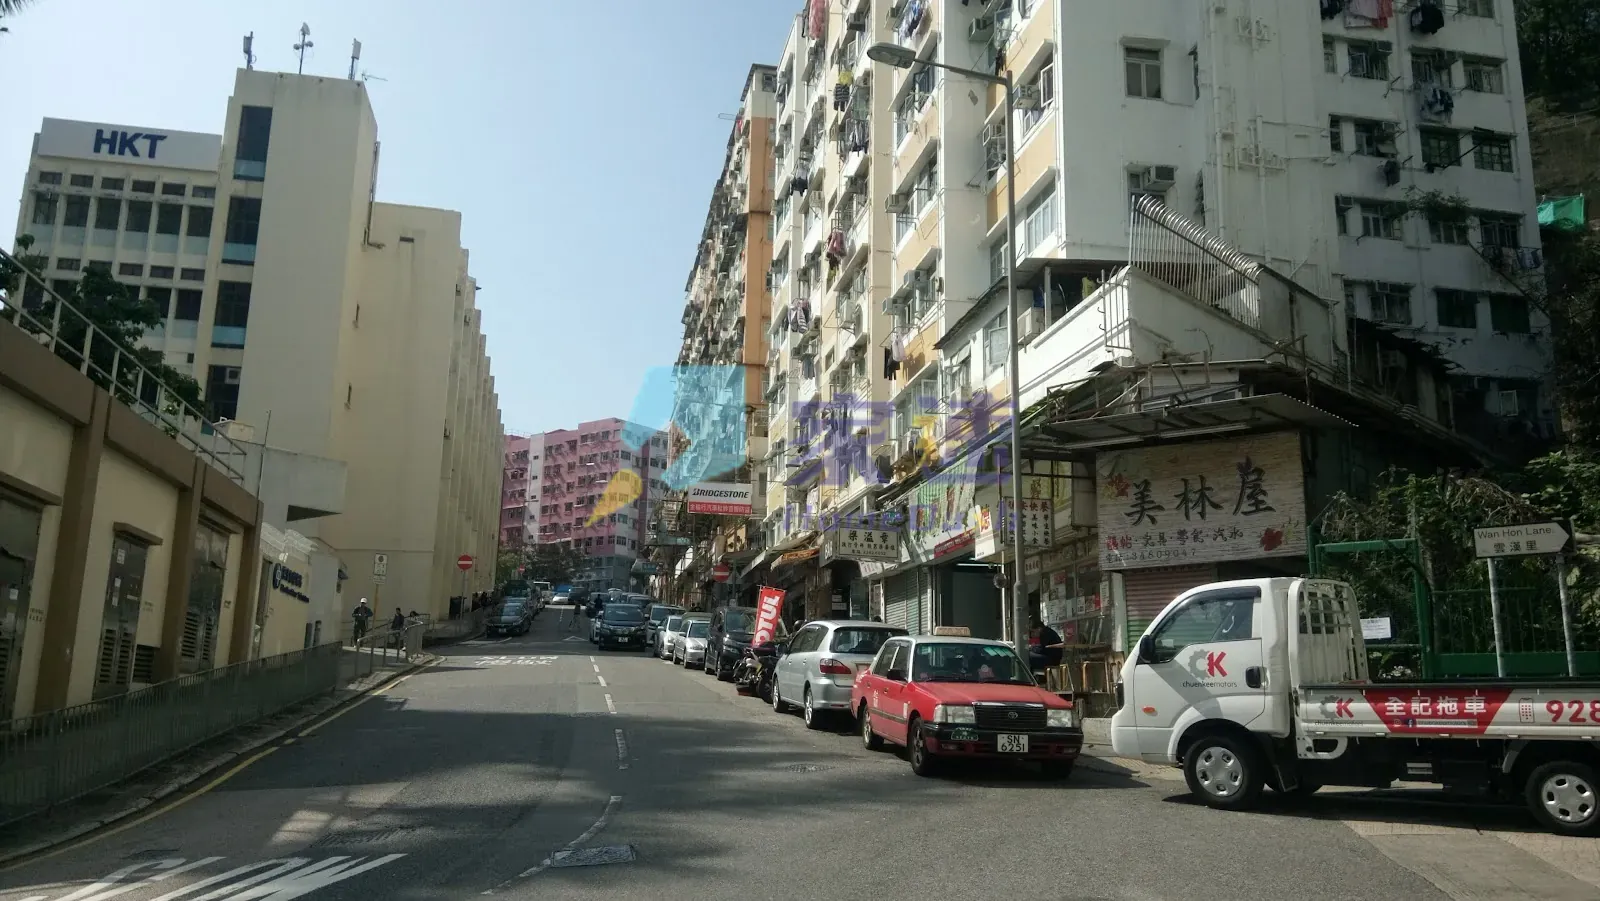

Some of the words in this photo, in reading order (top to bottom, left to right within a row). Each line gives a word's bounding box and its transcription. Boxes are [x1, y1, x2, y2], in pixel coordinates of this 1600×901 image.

[93, 128, 168, 158] HKT
[691, 487, 750, 499] BRIDGESTONE
[1123, 456, 1276, 527] 美林屋
[1477, 530, 1500, 539] Wan
[1502, 528, 1523, 537] Hon
[1525, 526, 1552, 536] Lane
[1493, 540, 1538, 553] 雲漢里
[755, 595, 781, 645] OTUL
[1384, 696, 1487, 717] 全記拖車
[1006, 735, 1021, 744] SN
[1001, 743, 1025, 752] 6251
